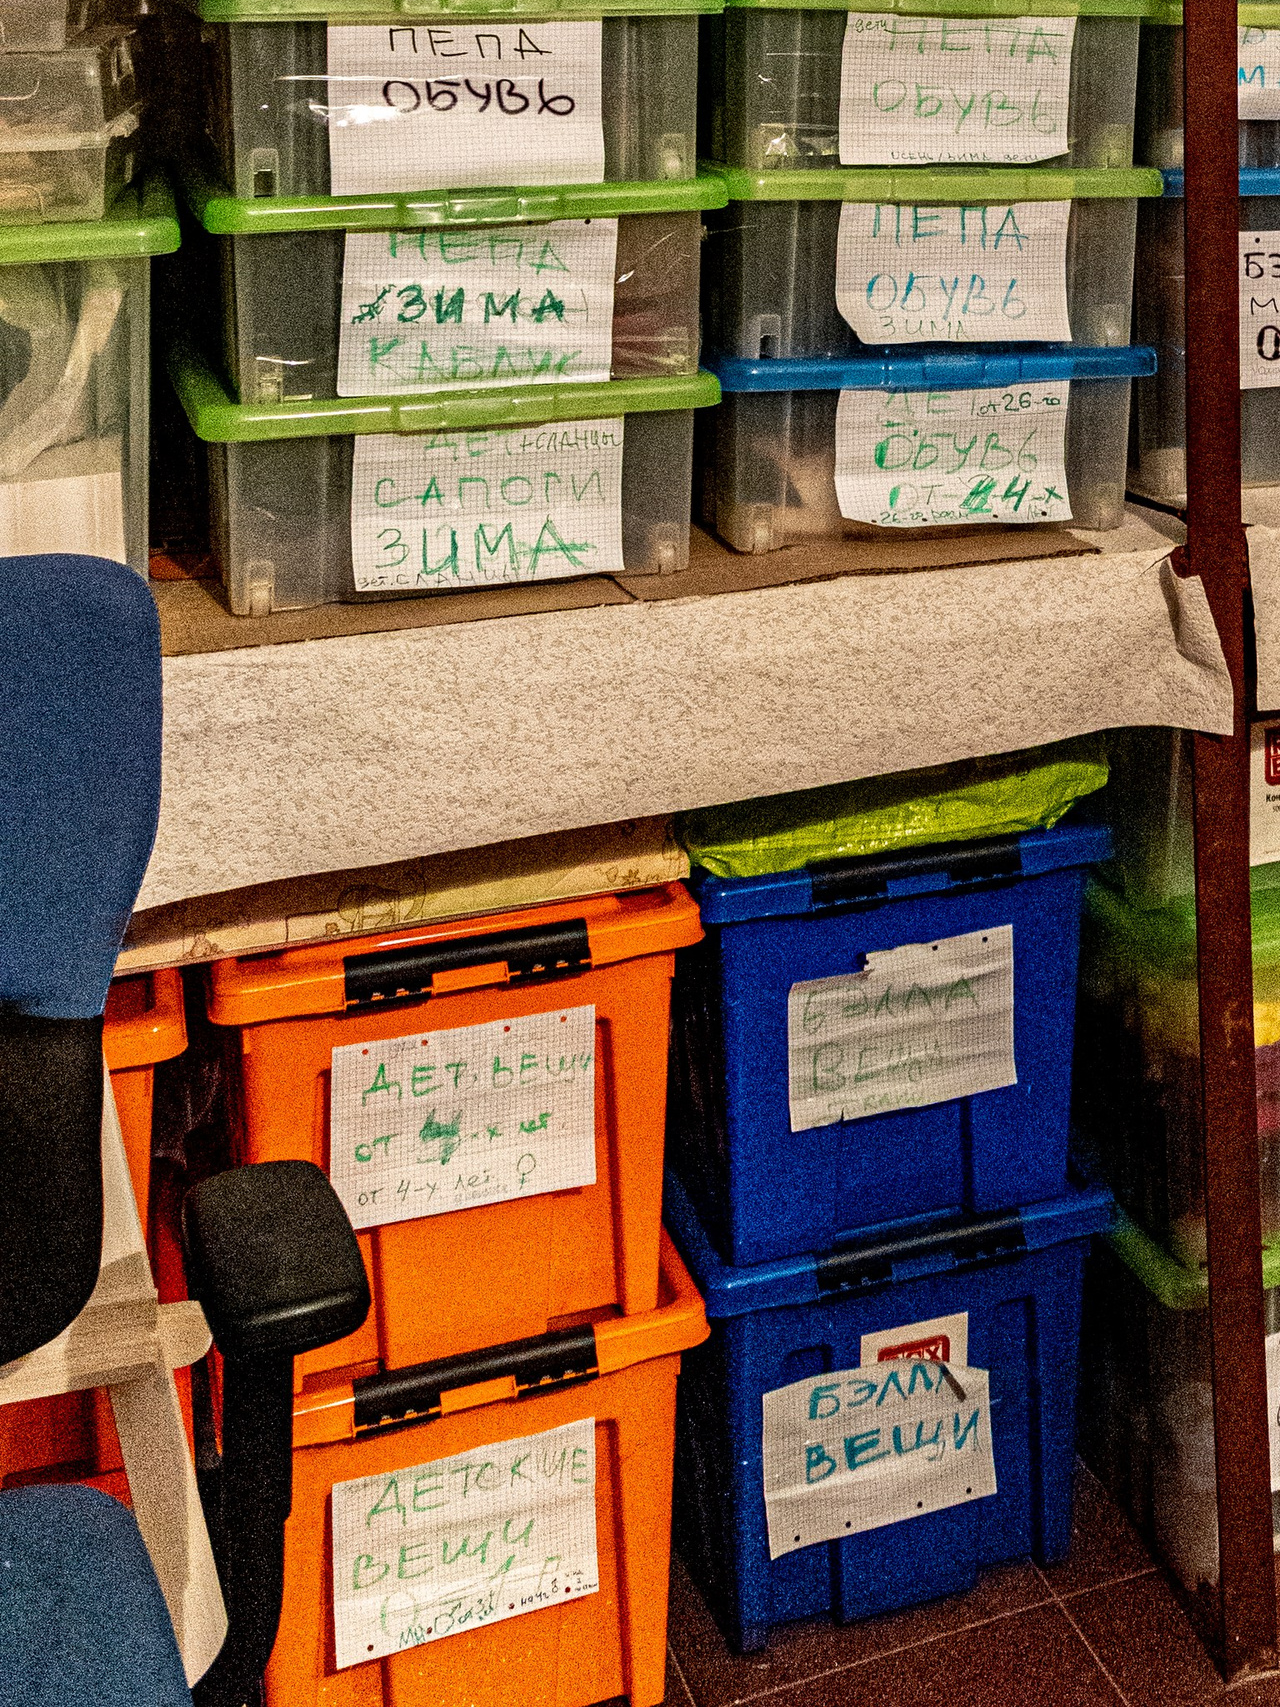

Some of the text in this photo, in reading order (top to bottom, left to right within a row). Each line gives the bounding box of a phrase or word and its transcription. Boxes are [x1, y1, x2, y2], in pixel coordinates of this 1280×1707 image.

[389, 28, 553, 60] ПЕПА
[383, 78, 575, 116] ОБУВЬ
[873, 79, 1056, 134] ОБУВЬ
[873, 203, 1028, 251] ПЕПА
[396, 284, 566, 324] ЗИМА
[866, 271, 1029, 320] ОБУВЬ
[879, 315, 971, 340] ЗИМА
[874, 428, 1038, 475] ОБУВЬ
[374, 470, 605, 509] САПОГИ
[375, 514, 597, 575] ЗИМА
[806, 1408, 983, 1485] ВЕЩИ
[366, 1448, 589, 1527] ДЕТСКИЕ
